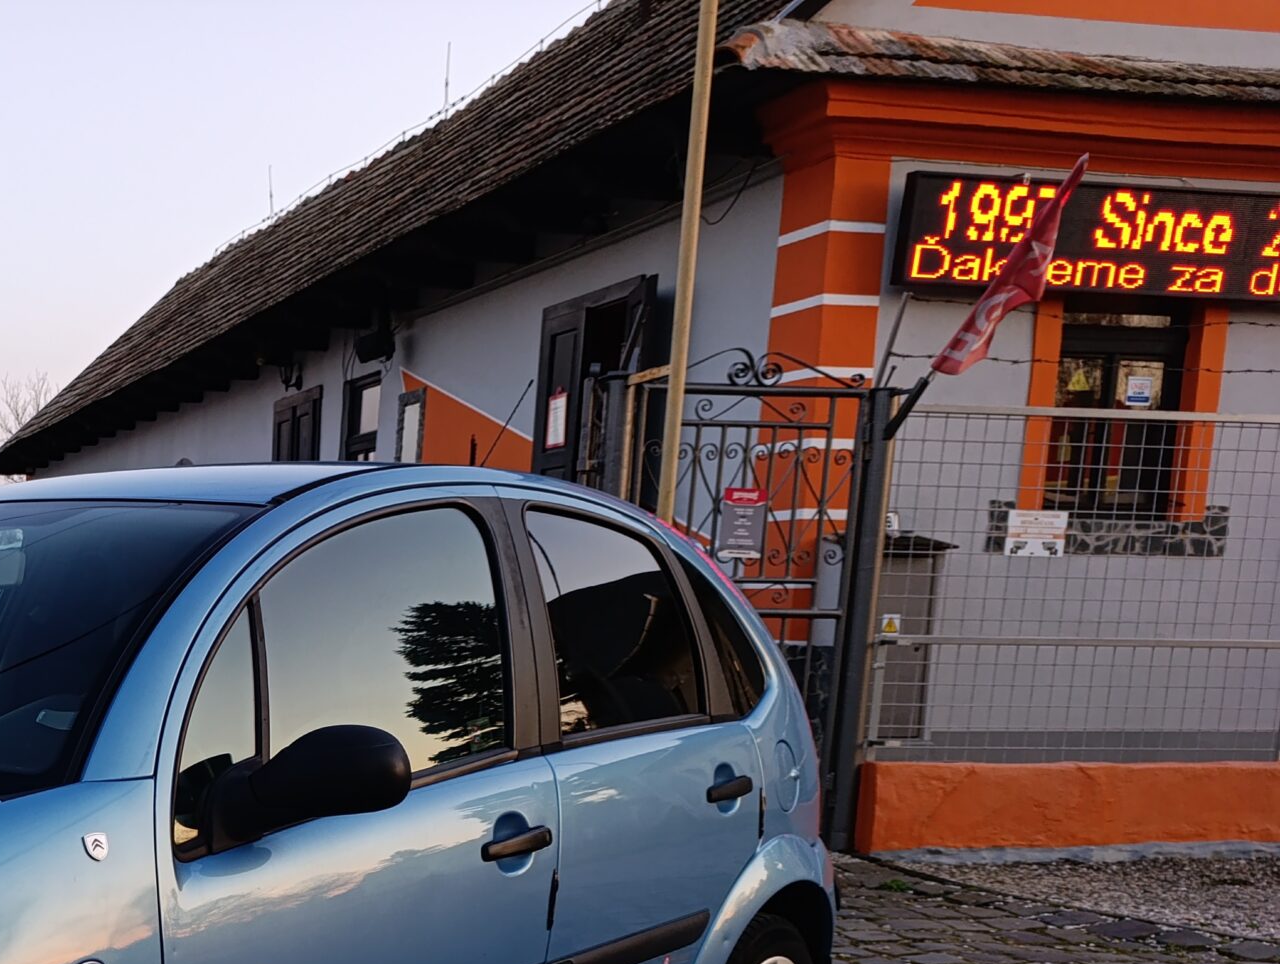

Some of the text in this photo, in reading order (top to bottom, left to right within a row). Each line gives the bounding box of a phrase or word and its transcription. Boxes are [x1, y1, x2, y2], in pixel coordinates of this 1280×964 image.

[940, 182, 1056, 244] 199
[1095, 191, 1233, 255] Since
[910, 235, 1145, 288] Ďakeme
[1168, 265, 1224, 293] za
[1250, 263, 1280, 297] d
